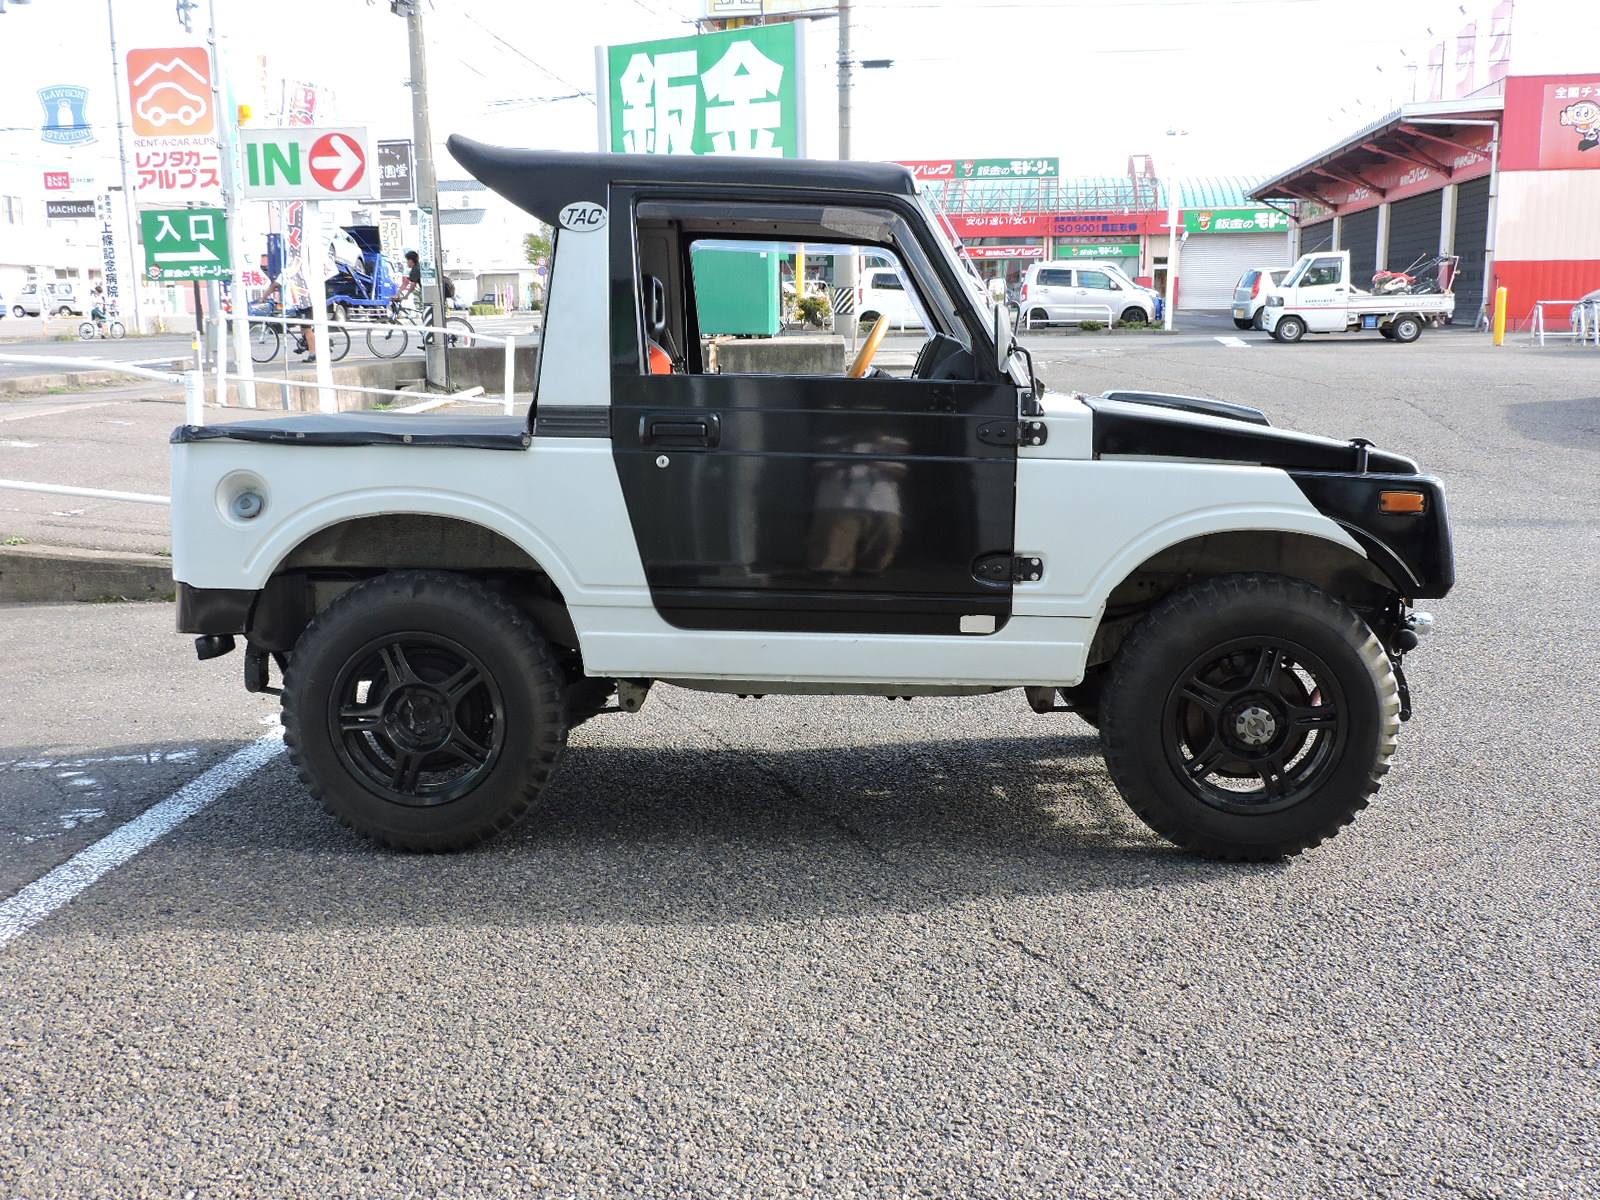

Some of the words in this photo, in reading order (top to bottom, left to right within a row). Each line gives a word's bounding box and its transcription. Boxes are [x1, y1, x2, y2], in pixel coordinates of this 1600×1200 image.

[42, 87, 85, 101] LAWSON
[619, 40, 784, 158] 鈑金
[46, 128, 89, 141] STATION
[134, 137, 190, 148] RENT-A-CAR
[192, 136, 216, 146] ALPS
[136, 150, 218, 168] レンタカー
[246, 142, 302, 187] IN
[137, 168, 219, 189] アルプス
[48, 205, 77, 213] MACHI
[566, 208, 602, 225] TAC
[155, 214, 215, 242] 入口
[1055, 224, 1073, 233] ISO
